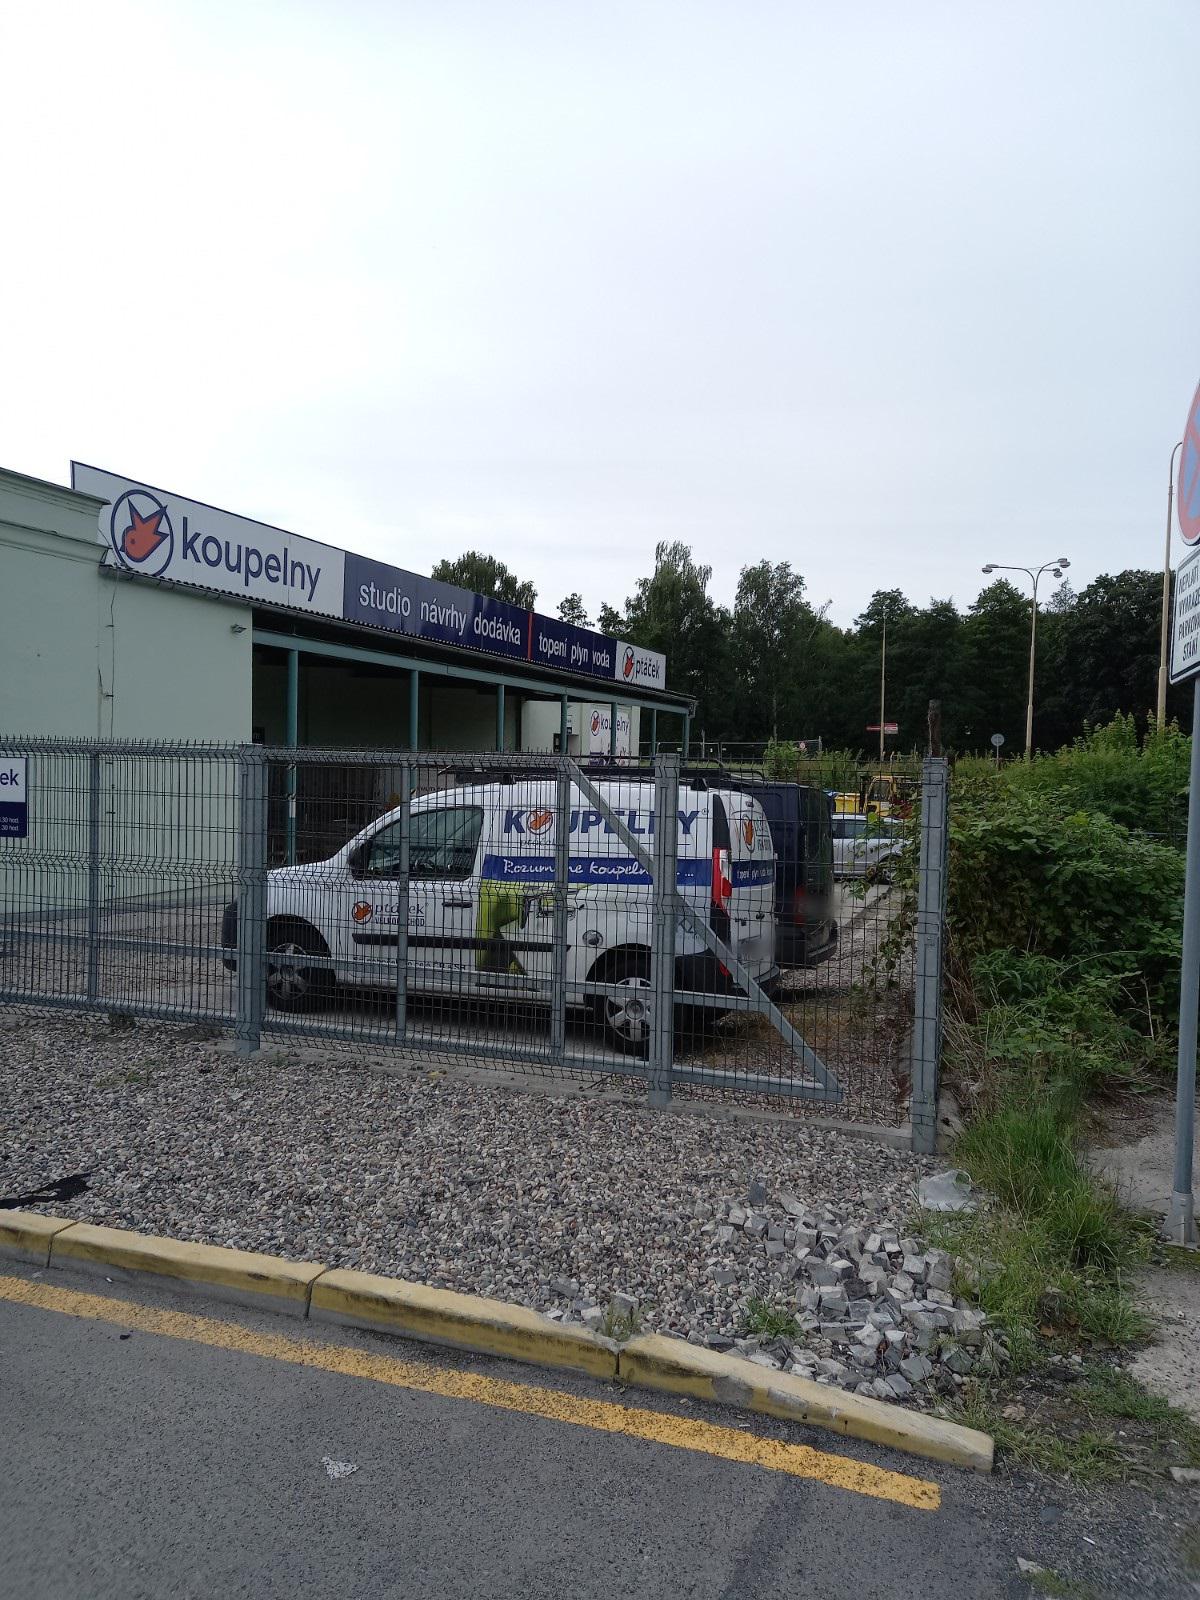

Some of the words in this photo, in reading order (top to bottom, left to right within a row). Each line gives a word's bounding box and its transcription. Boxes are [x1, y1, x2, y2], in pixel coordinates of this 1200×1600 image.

[182, 516, 321, 602] koupelny
[359, 581, 411, 617] studio
[420, 597, 467, 637] návrhy
[473, 611, 521, 646] dodávka
[538, 633, 568, 657] topení
[570, 644, 589, 664] plyn
[592, 648, 611, 668] voda
[634, 656, 661, 680] ptáček
[600, 713, 629, 735] kouelny
[375, 902, 424, 916] ptáek
